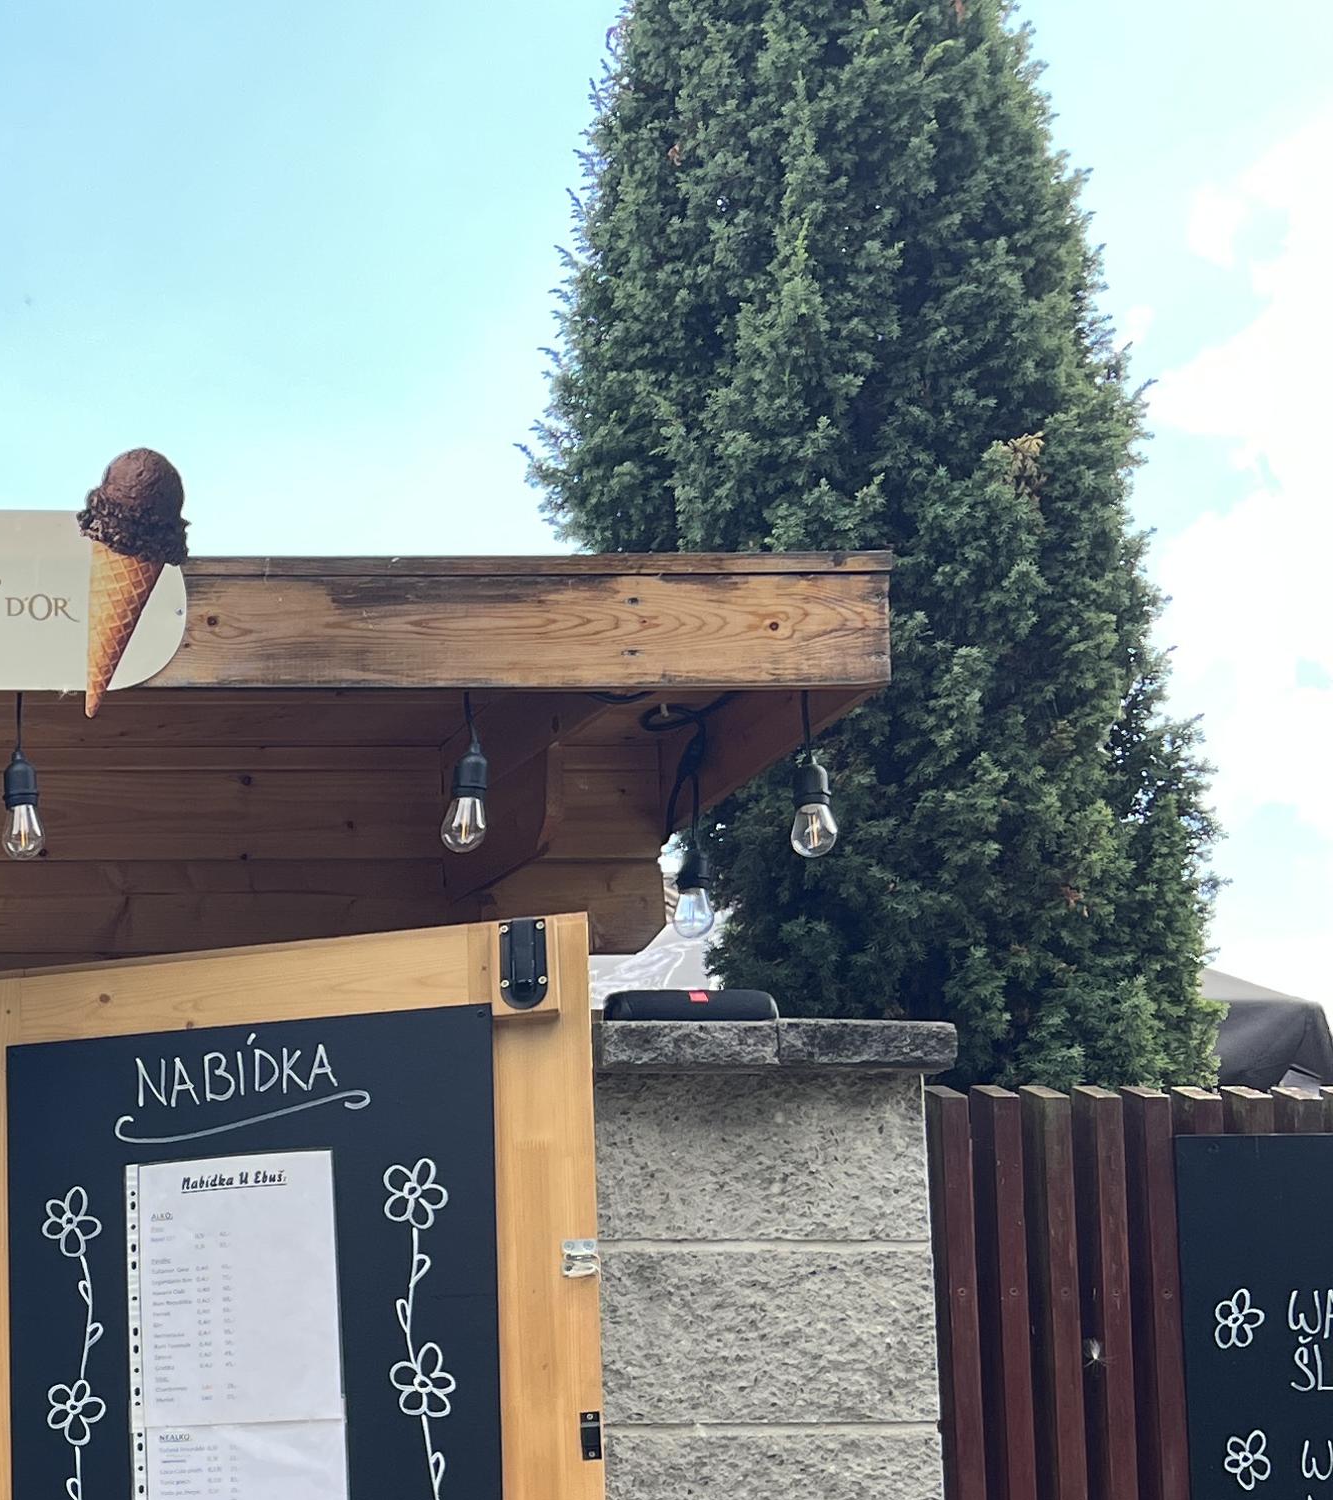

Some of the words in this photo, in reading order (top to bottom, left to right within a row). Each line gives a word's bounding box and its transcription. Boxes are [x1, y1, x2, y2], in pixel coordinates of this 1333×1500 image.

[6, 593, 80, 623] D'OR
[135, 1032, 338, 1108] NABÍDKA
[181, 1173, 234, 1191] Nabídka
[239, 1171, 249, 1186] U
